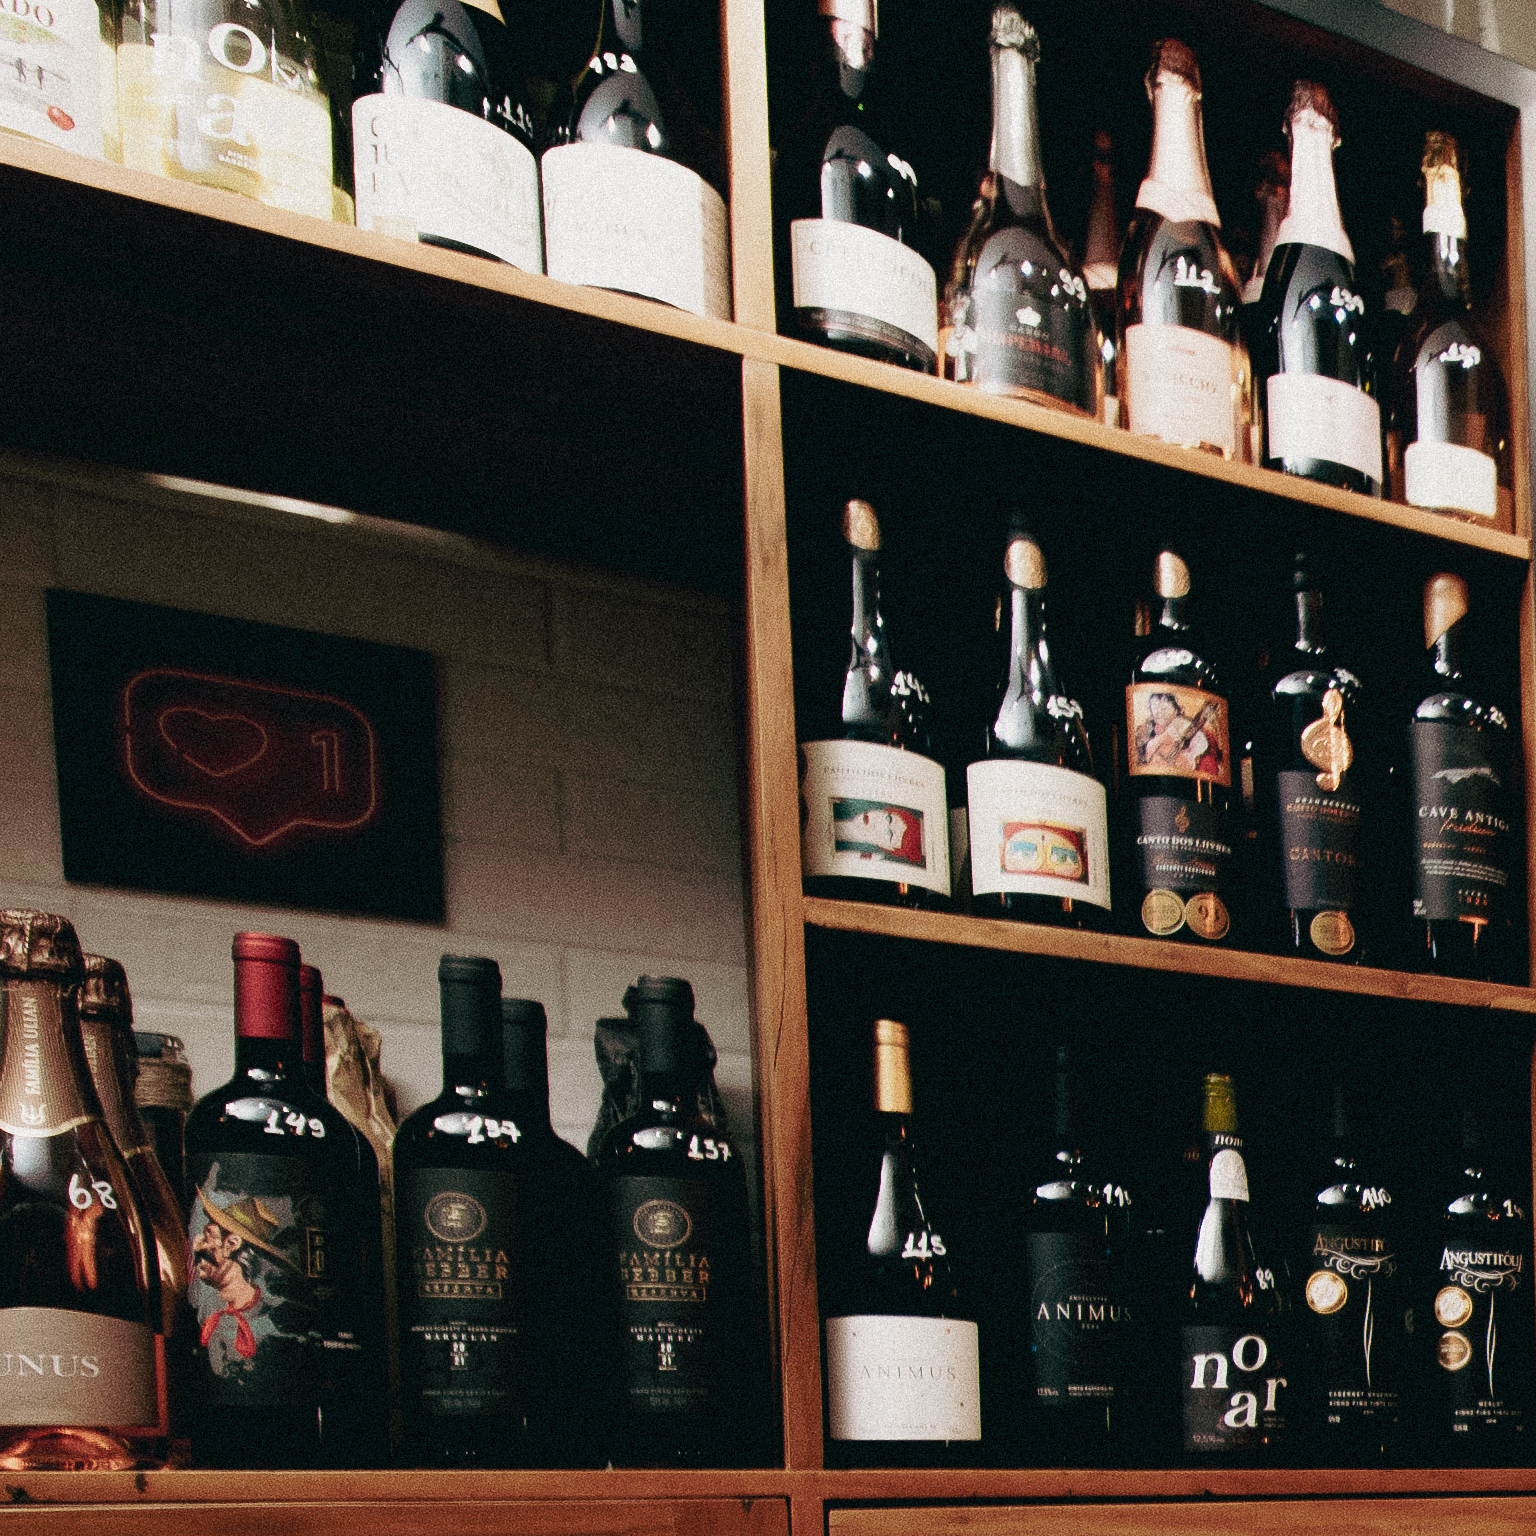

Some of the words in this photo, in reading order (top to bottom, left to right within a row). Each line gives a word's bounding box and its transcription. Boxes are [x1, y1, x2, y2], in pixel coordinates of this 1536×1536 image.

[1418, 806, 1459, 820] CAVE
[263, 1109, 326, 1138] 149
[687, 1134, 731, 1162] 137
[68, 1173, 118, 1210] 68
[901, 1230, 948, 1259] 115
[1036, 1302, 1132, 1322] ANIMUS
[860, 1364, 958, 1381] ANIMUS
